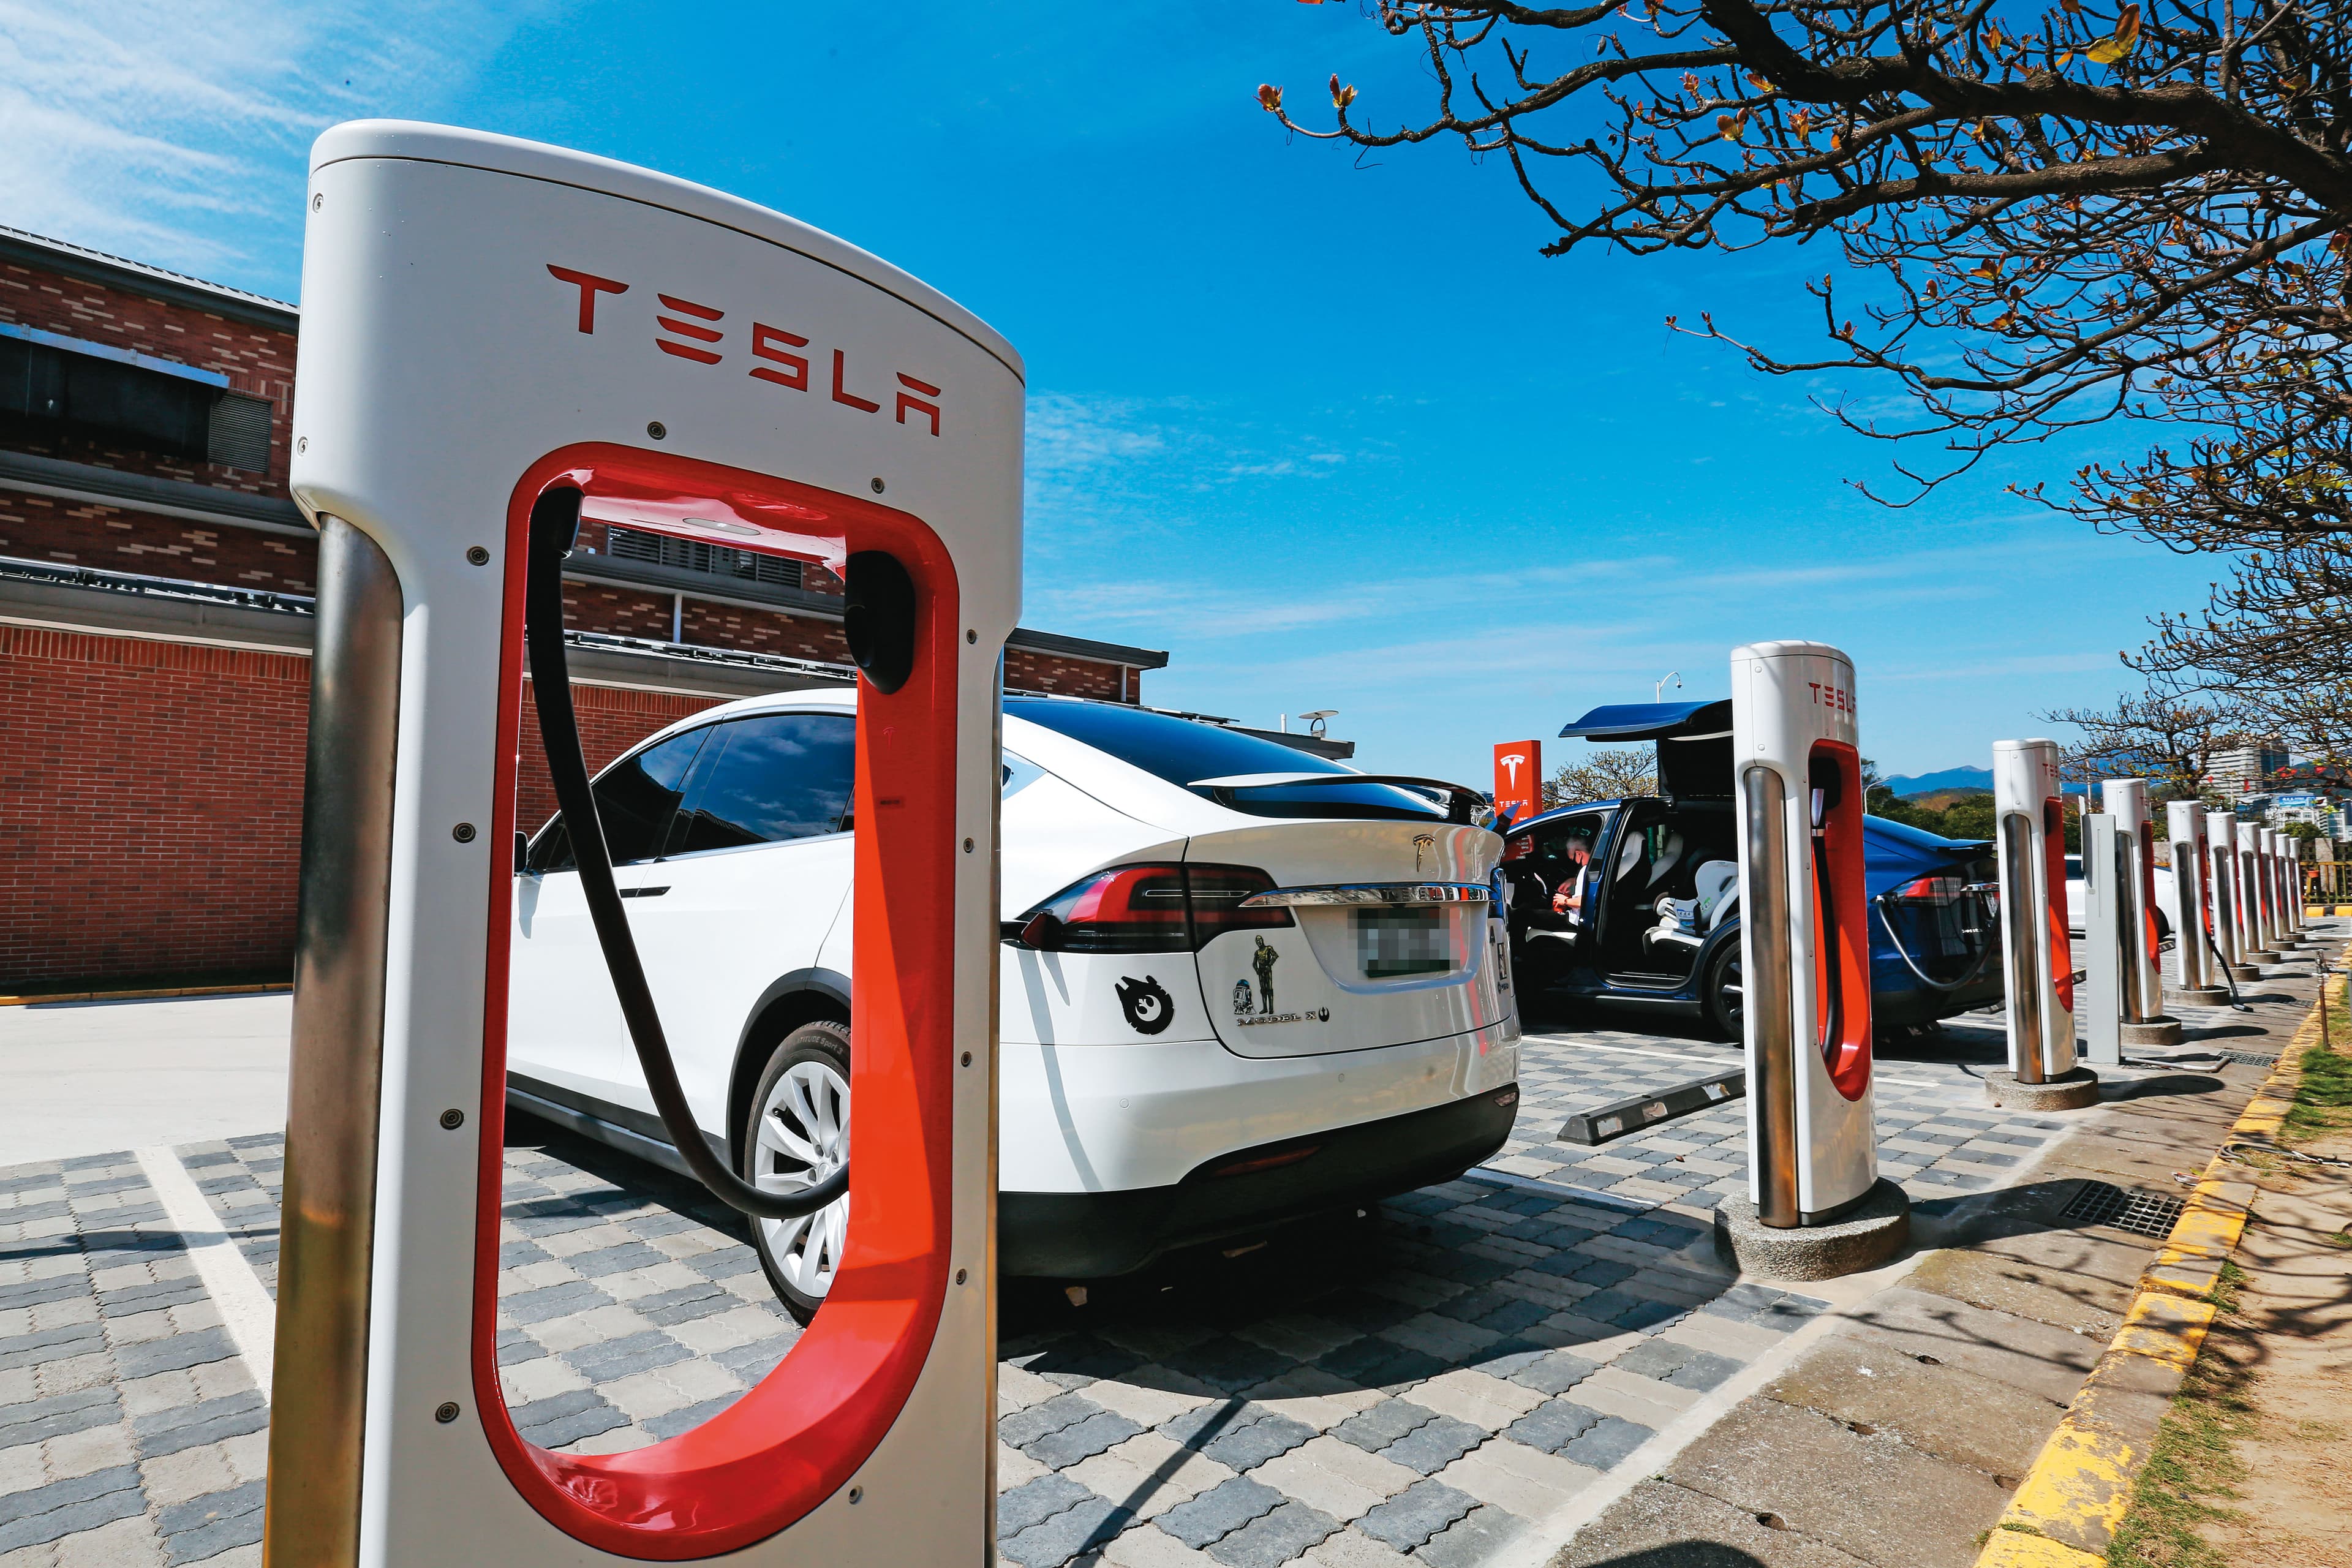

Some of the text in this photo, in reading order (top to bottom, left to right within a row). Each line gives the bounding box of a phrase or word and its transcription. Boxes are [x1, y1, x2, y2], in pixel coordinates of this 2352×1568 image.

[546, 263, 941, 437] TESLA
[1235, 1011, 1317, 1027] MODEL X
[797, 1035, 821, 1044] ATITUDE
[820, 1036, 838, 1051] Sport
